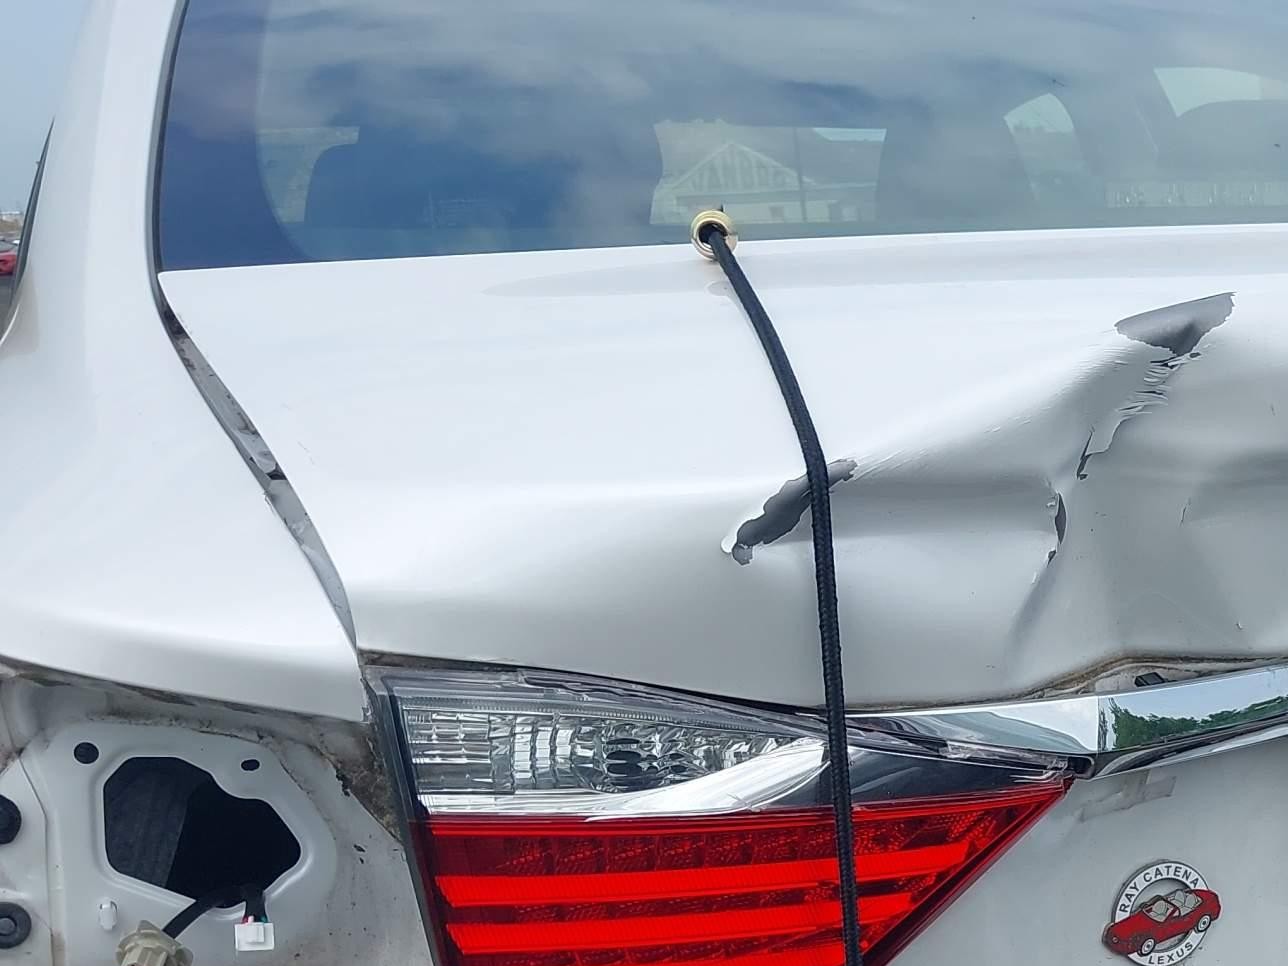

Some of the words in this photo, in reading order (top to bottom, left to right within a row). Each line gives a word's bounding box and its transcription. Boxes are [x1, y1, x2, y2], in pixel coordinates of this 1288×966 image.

[1119, 881, 1140, 912] RAY
[1143, 865, 1200, 888] CATENA
[1148, 941, 1194, 965] LEXUS
